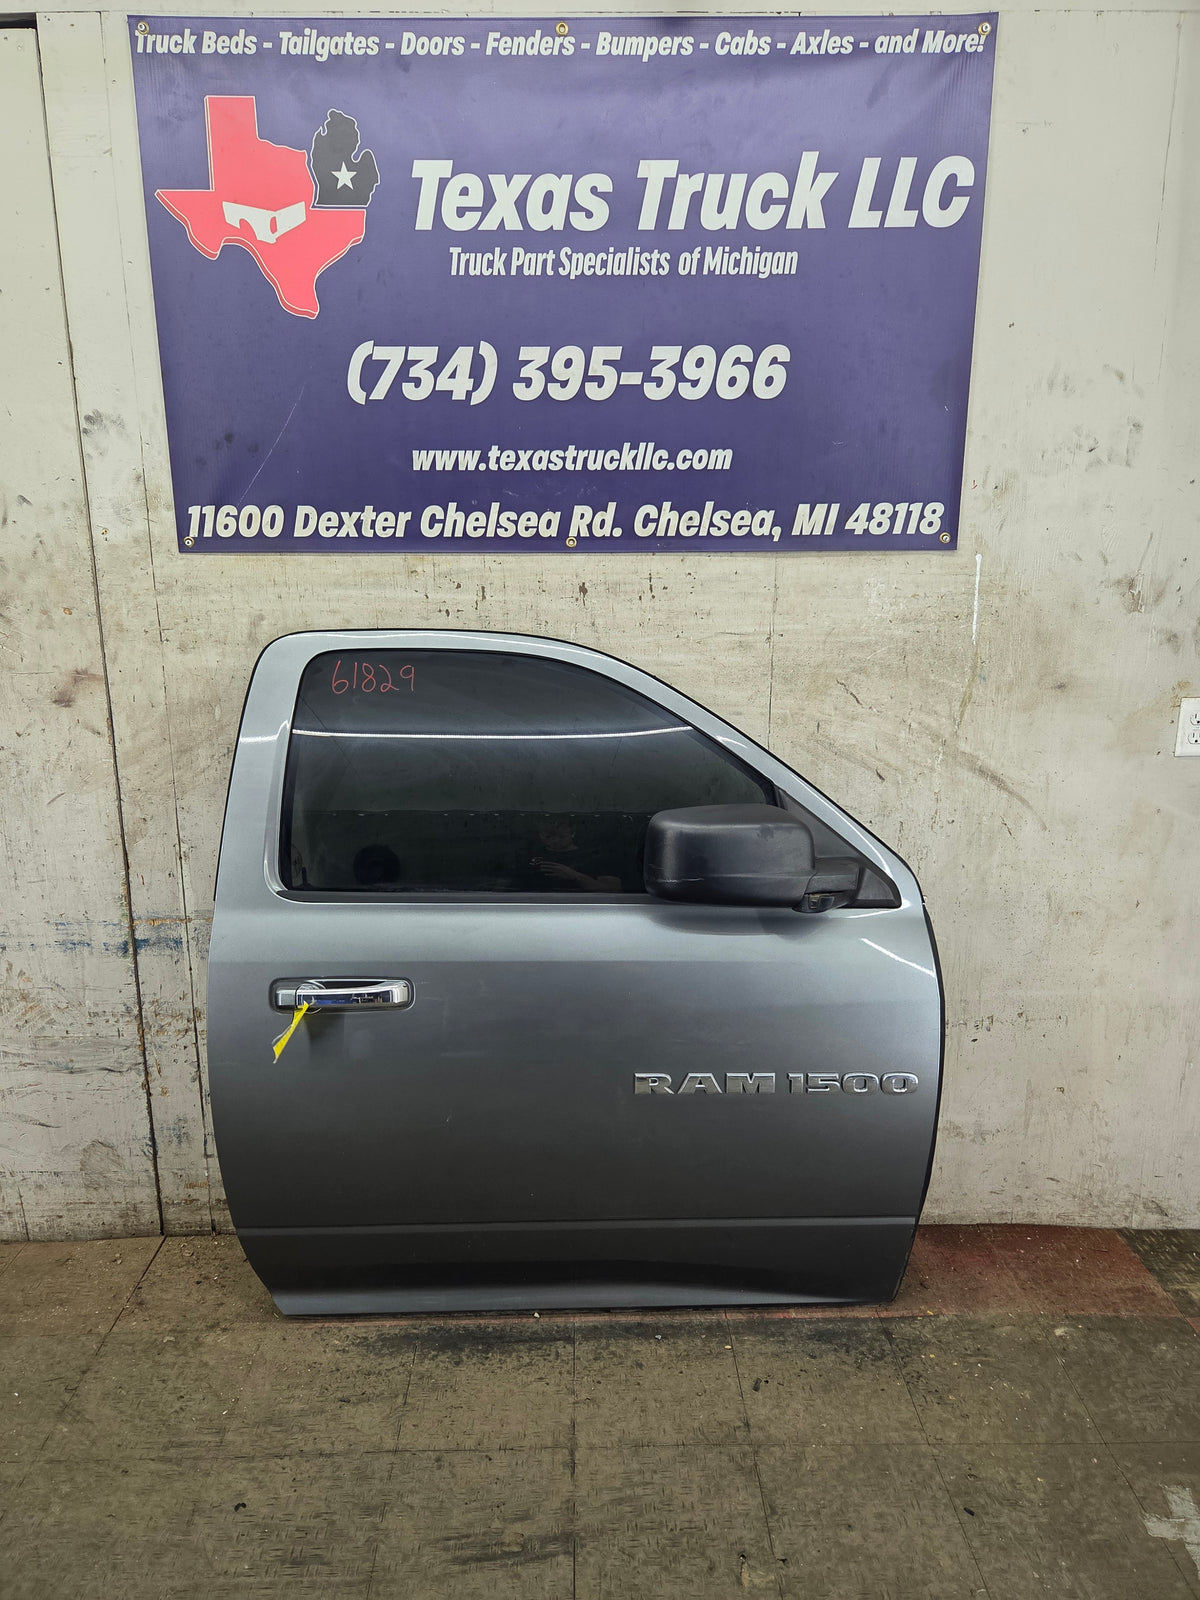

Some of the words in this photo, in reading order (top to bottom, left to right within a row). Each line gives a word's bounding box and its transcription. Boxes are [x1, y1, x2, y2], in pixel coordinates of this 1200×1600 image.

[134, 28, 197, 53] Truck
[201, 28, 257, 54] Beds
[279, 27, 379, 61] Tailgates
[400, 31, 465, 55] Doors
[485, 29, 576, 56] Fenders
[595, 31, 694, 61] Bumpers
[714, 29, 771, 54] Cabs
[789, 28, 854, 54] Axles
[874, 28, 919, 53] and
[921, 29, 987, 53] More!
[411, 159, 612, 231] Texas
[636, 150, 838, 230] Truck
[847, 155, 974, 228] LLC
[449, 246, 506, 275] Truck
[510, 247, 555, 275] Part
[558, 246, 670, 279] Specialists
[678, 246, 701, 275] of
[702, 246, 798, 278] Michigan
[347, 340, 497, 405] (734)
[512, 344, 790, 400] 395-3966
[412, 442, 732, 470] www.texastruckllc.com
[187, 505, 285, 538] 11600
[293, 505, 411, 537] Dexter
[420, 502, 561, 537] Chelsea
[568, 501, 622, 537] Rd.
[634, 501, 781, 541] Chelsea,
[791, 503, 839, 535] MI
[844, 502, 944, 536] 48118
[333, 660, 414, 694] 61829
[634, 1072, 776, 1095] RAM
[787, 1072, 919, 1095] 1500
